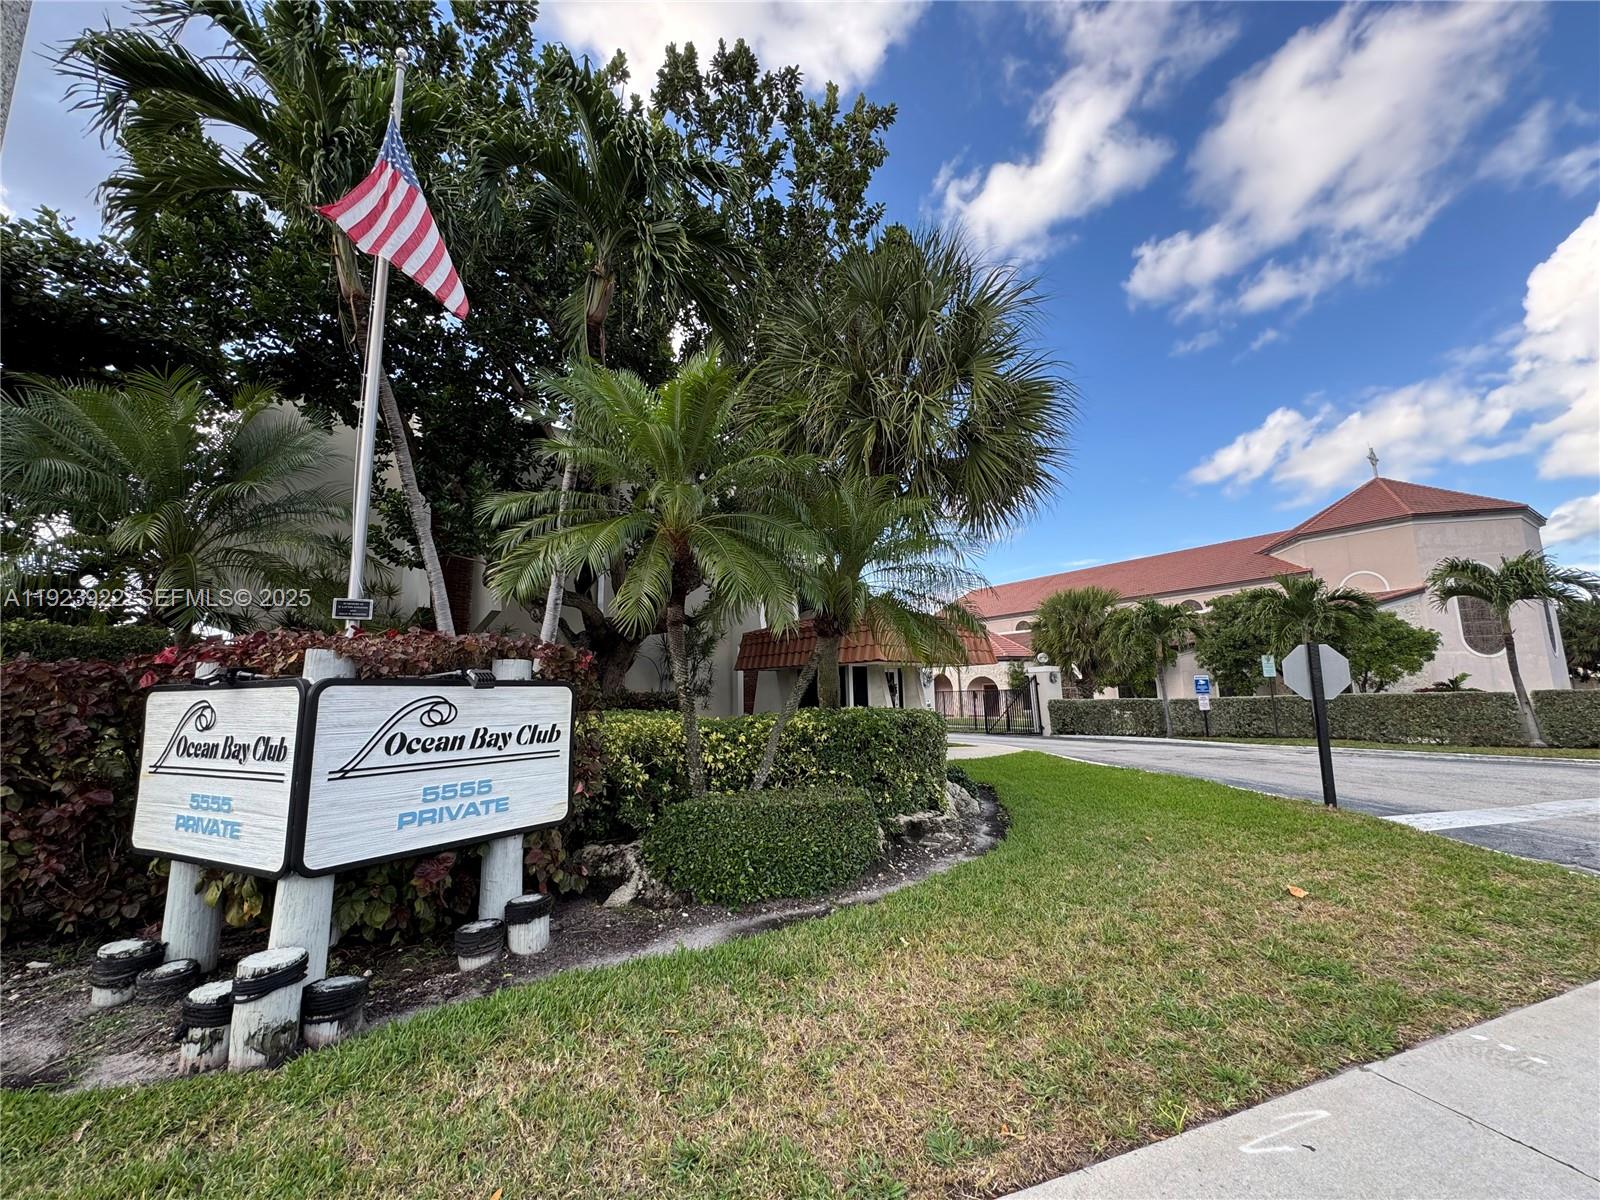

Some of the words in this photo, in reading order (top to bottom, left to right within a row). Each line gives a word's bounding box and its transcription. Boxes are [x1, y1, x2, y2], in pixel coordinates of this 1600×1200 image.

[176, 735, 219, 758] Ocean
[220, 735, 251, 765] Bay
[252, 735, 288, 762] Club
[384, 731, 466, 756] Ocean
[469, 727, 513, 751] Bay
[516, 723, 562, 746] Club
[189, 793, 233, 813] 5555
[421, 778, 493, 803] 5555
[175, 814, 243, 839] PRIVATE
[397, 796, 510, 831] PRIVATE
